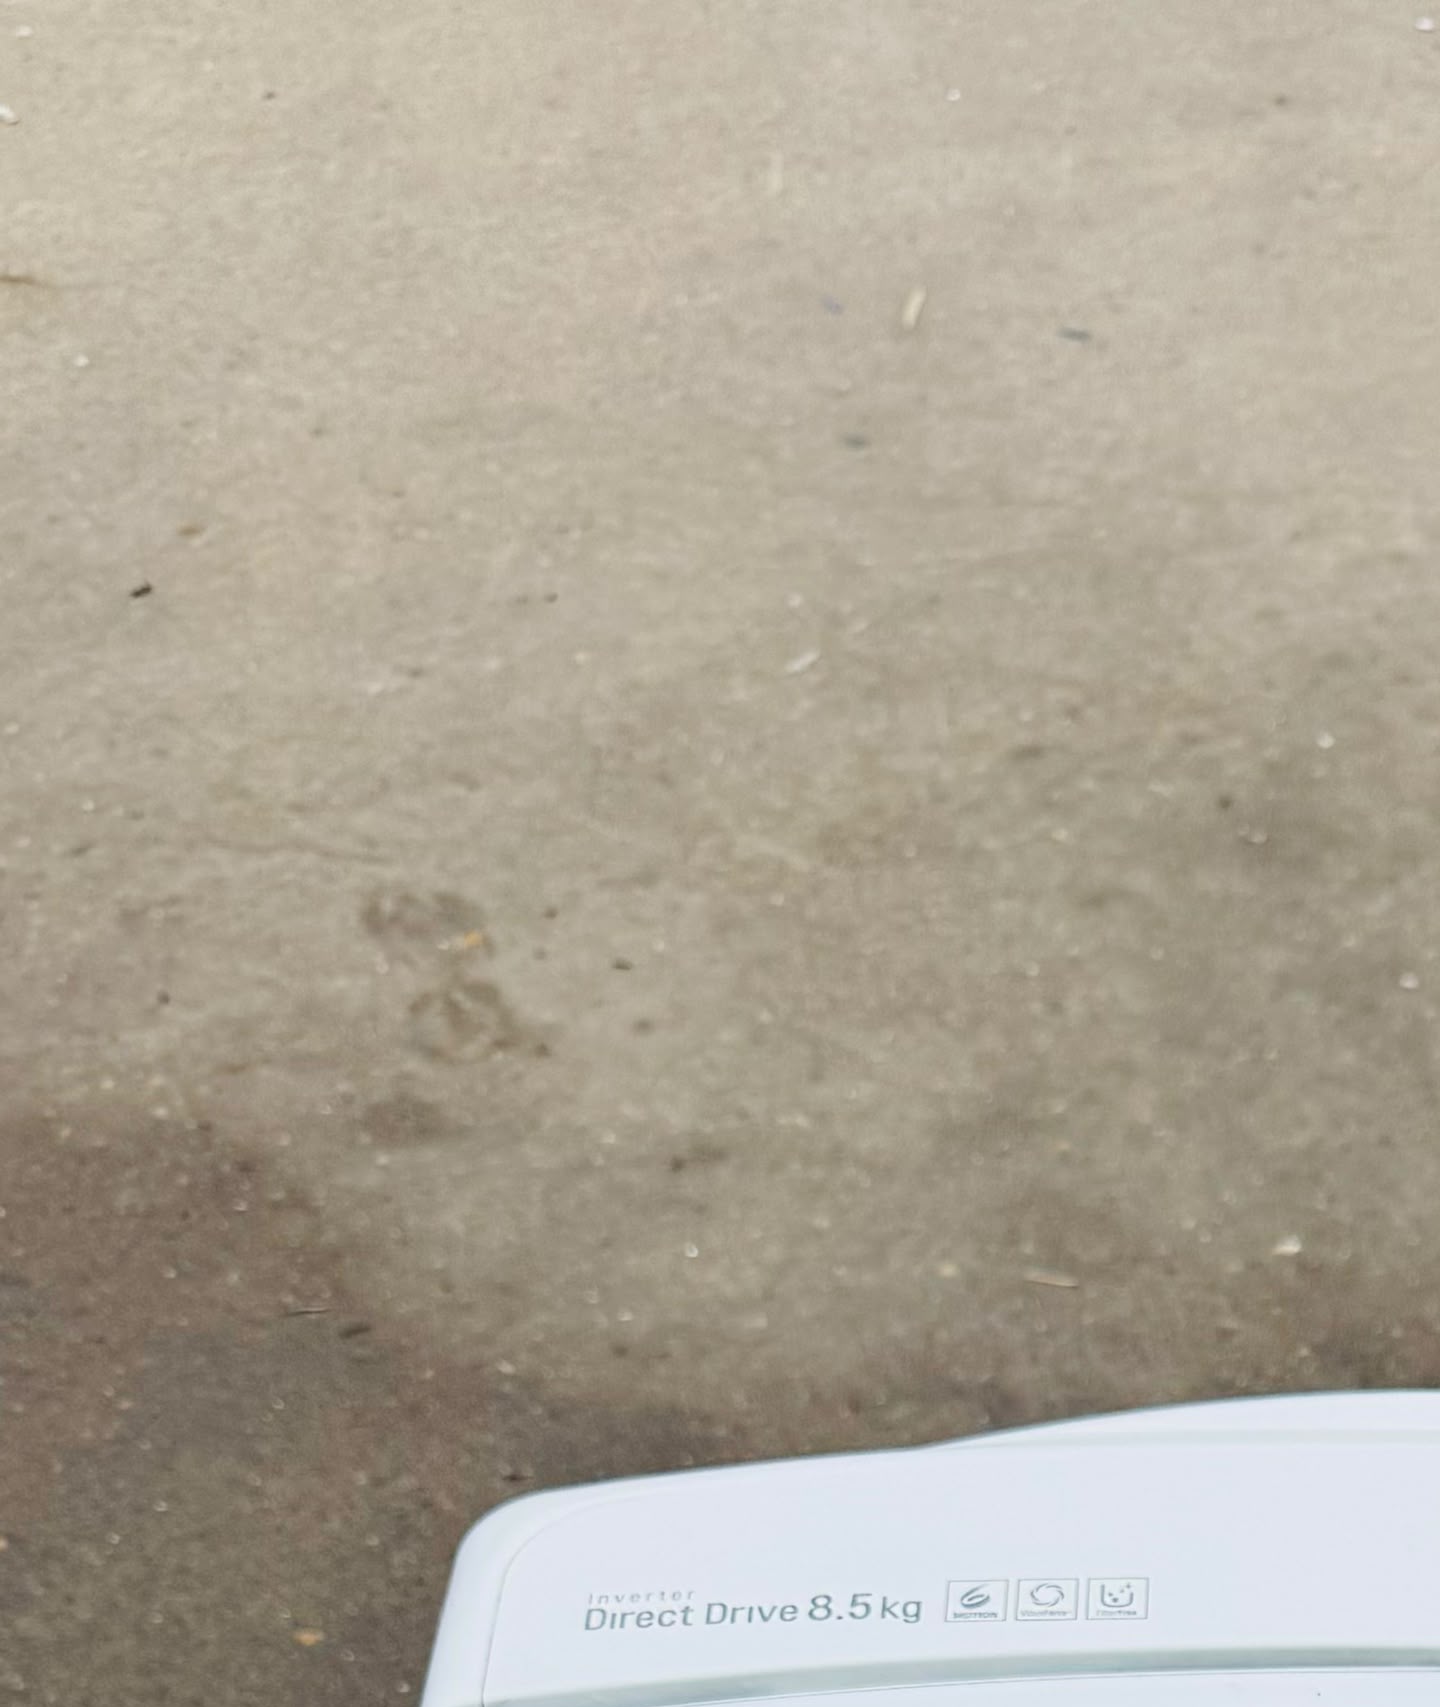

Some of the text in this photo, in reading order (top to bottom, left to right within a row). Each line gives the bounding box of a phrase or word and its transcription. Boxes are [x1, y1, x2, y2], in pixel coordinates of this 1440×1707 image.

[588, 1591, 695, 1604] Inverter
[584, 1593, 922, 1630] Direct Drive 8.5 kg
